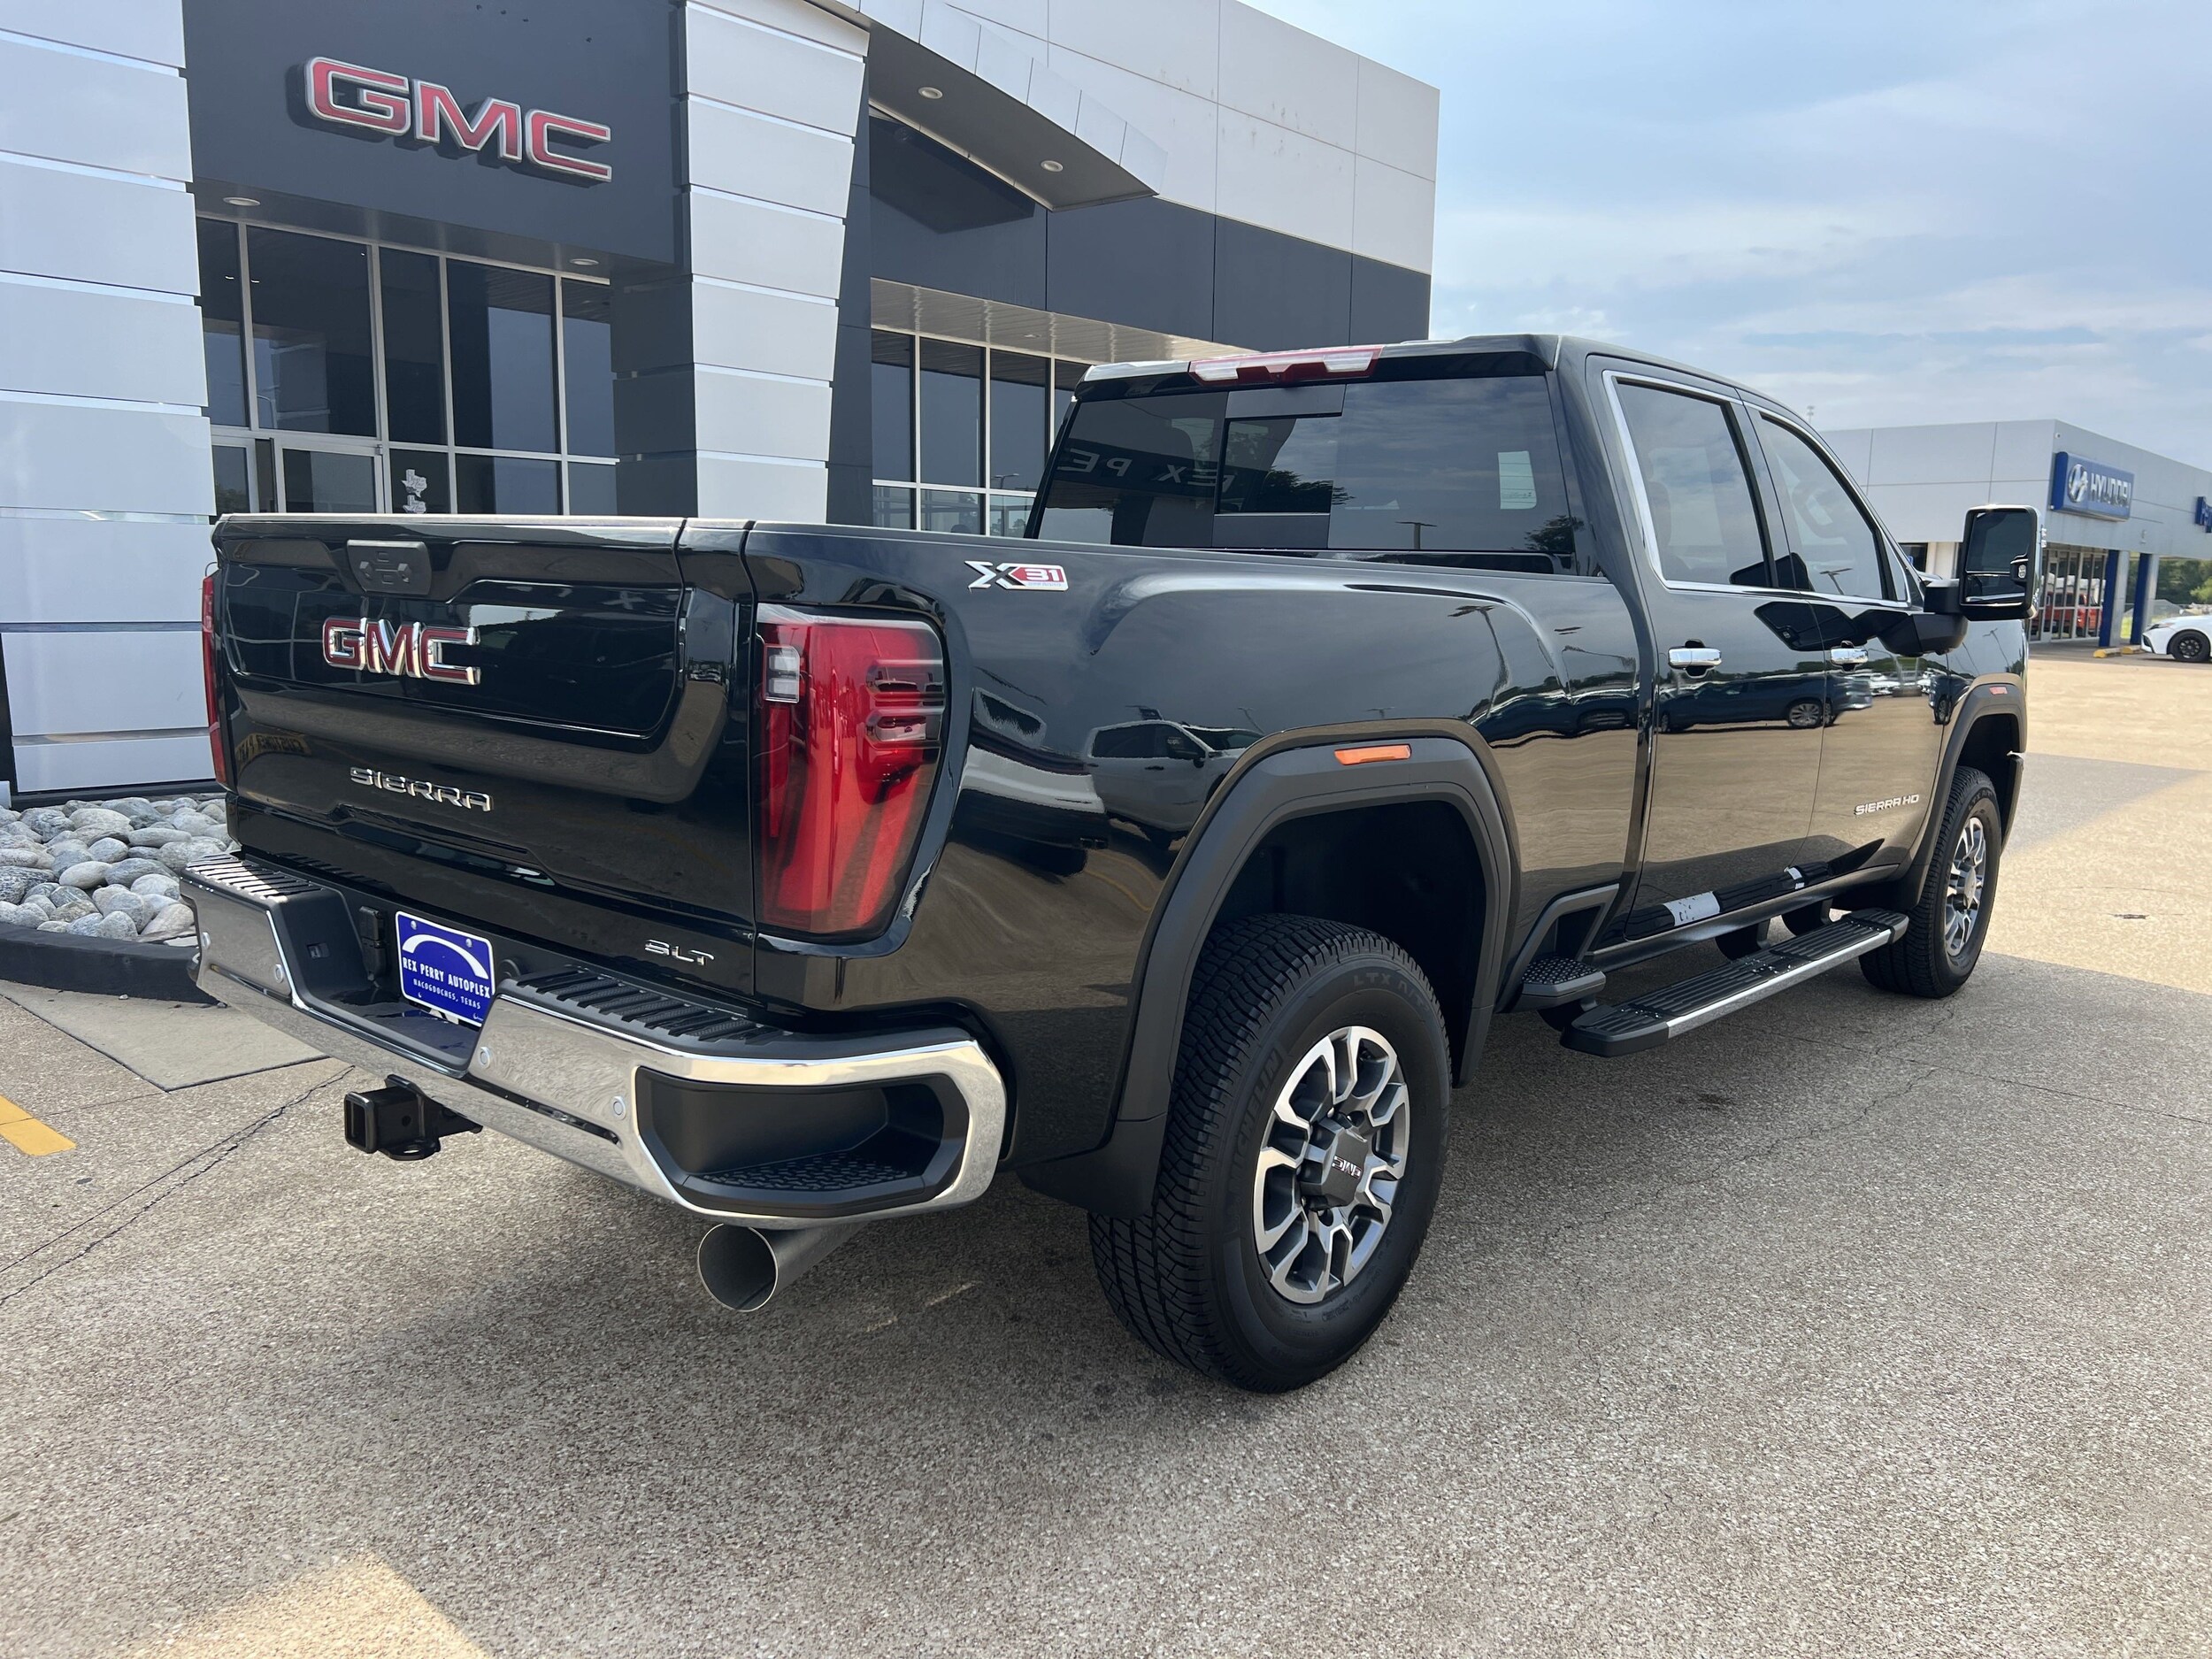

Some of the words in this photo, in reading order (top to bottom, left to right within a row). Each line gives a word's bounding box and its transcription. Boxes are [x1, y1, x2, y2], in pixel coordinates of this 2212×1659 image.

[306, 57, 612, 182] GMC
[964, 561, 1069, 591] X31
[322, 617, 481, 685] GMC
[350, 766, 494, 812] SIERRA
[1855, 797, 1901, 815] SIERRA
[1901, 794, 1920, 805] HD
[645, 939, 714, 965] SLT
[403, 956, 418, 972] REX
[419, 963, 444, 982] PERRY
[448, 973, 490, 998] AUTOPLEX
[413, 979, 458, 1002] NACOGDOCHES,
[460, 995, 480, 1010] TEXAS
[1332, 1155, 1363, 1179] GMC
